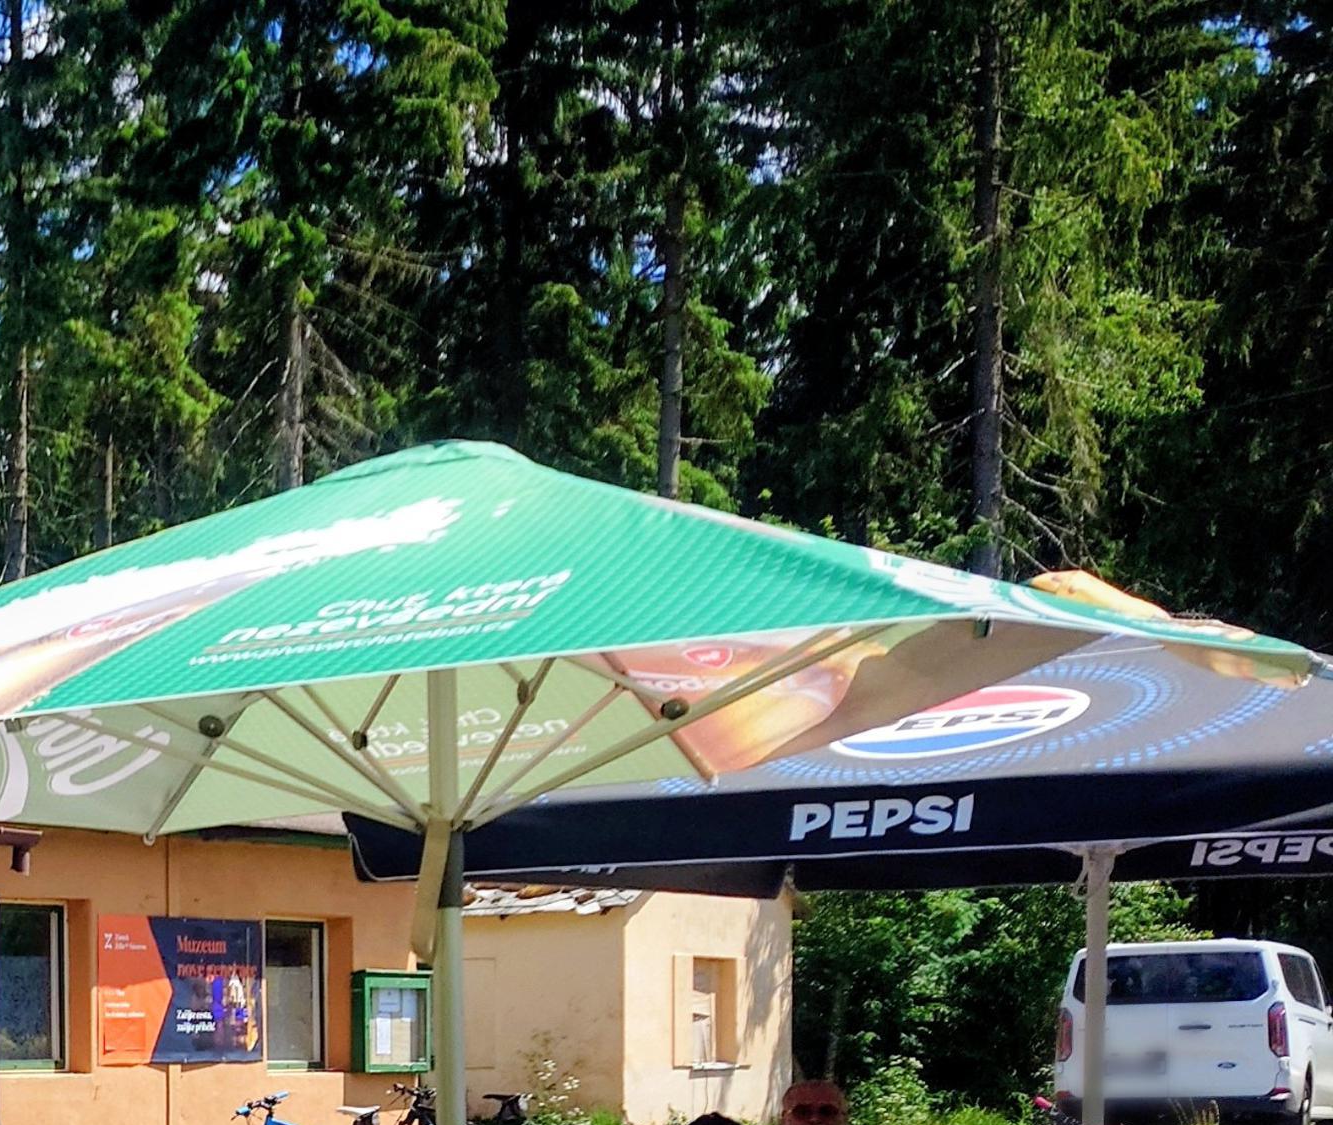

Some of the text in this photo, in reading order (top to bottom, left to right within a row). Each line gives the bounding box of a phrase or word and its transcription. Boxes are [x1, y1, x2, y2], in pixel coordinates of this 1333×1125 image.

[893, 706, 1071, 731] EPSI
[789, 793, 975, 841] PEPSI
[176, 934, 228, 955] Muzeum
